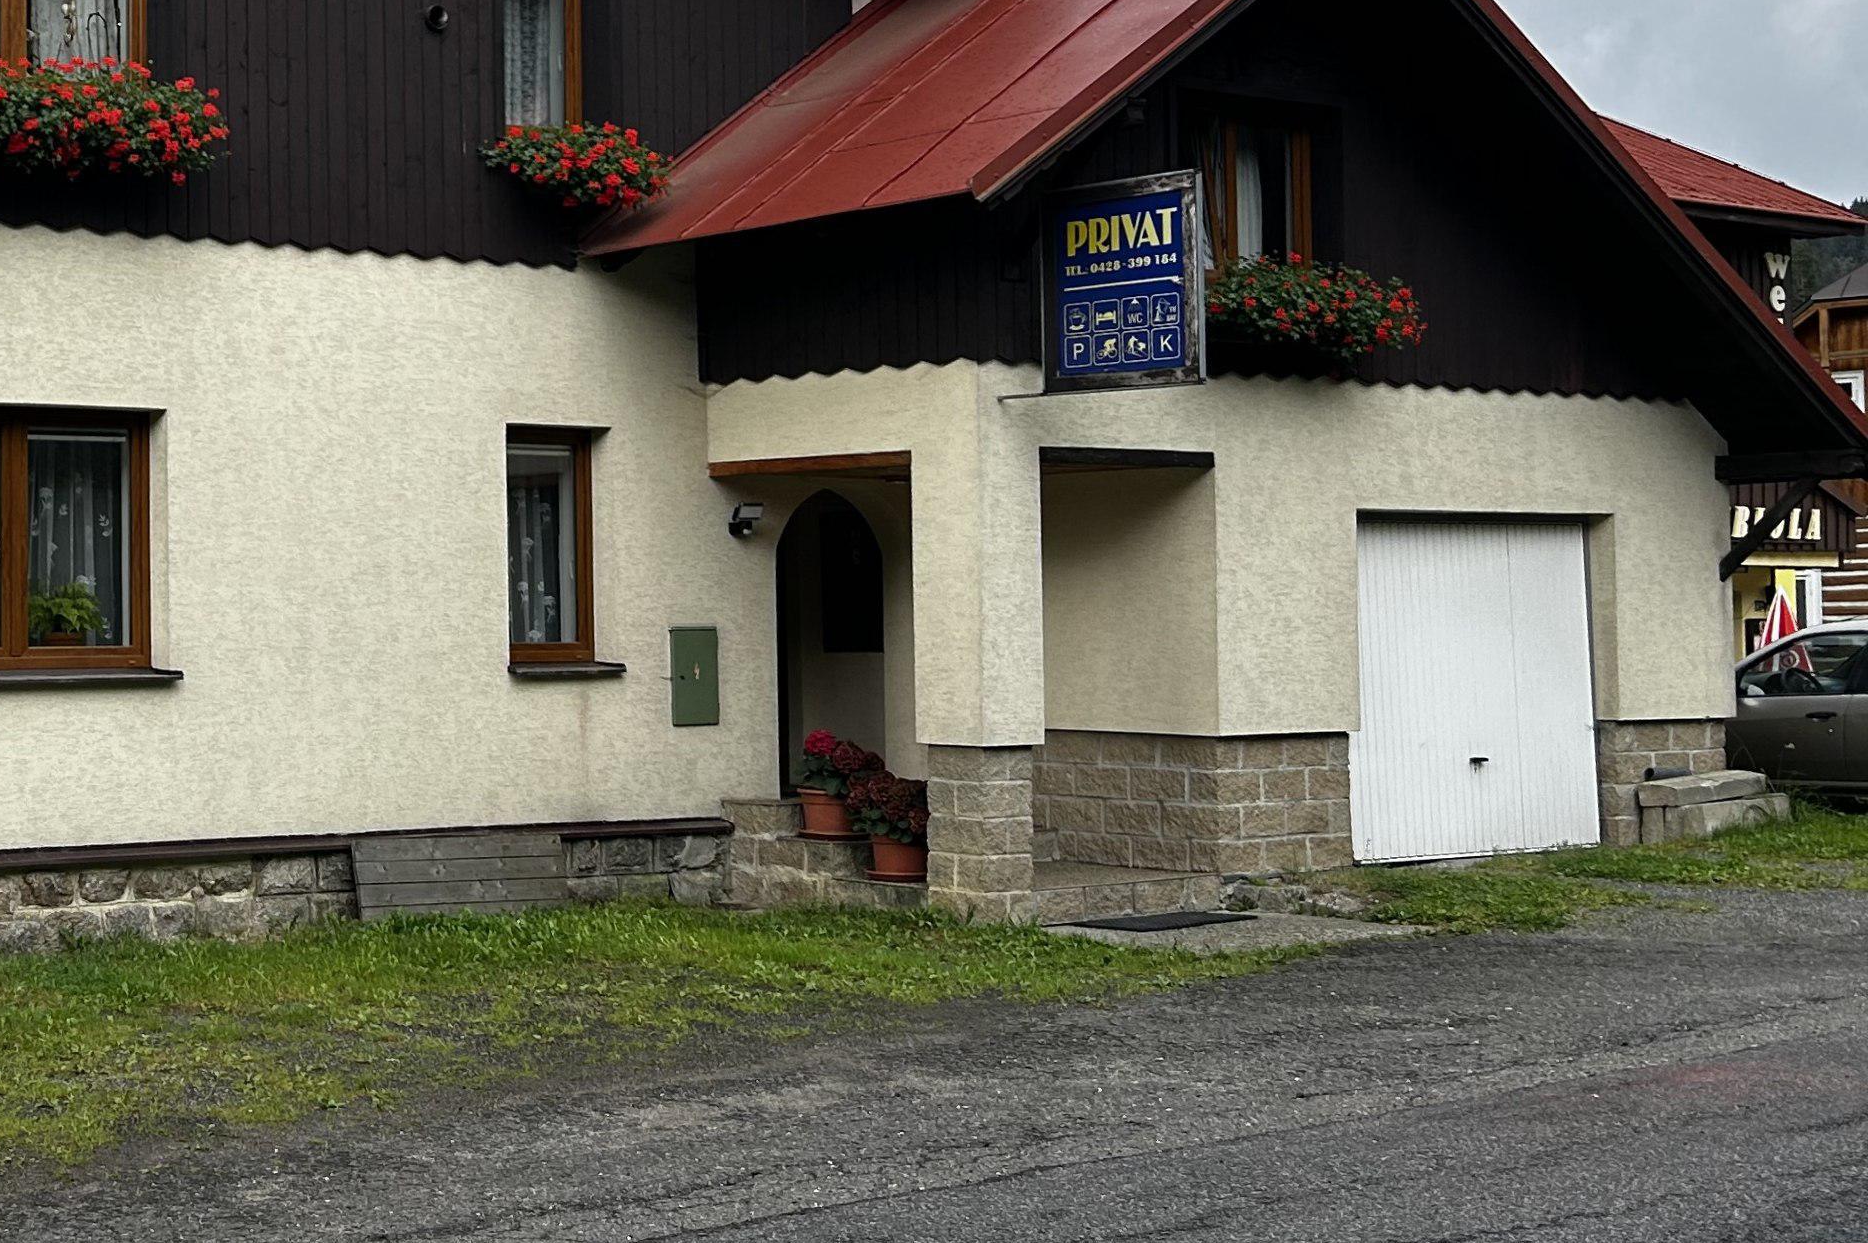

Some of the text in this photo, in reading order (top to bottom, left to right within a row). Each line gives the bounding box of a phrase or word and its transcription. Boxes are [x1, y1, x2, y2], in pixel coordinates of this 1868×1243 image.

[1067, 207, 1178, 257] PRIVAT
[1127, 311, 1143, 324] WC
[1073, 343, 1084, 360] P
[1160, 334, 1173, 352] K
